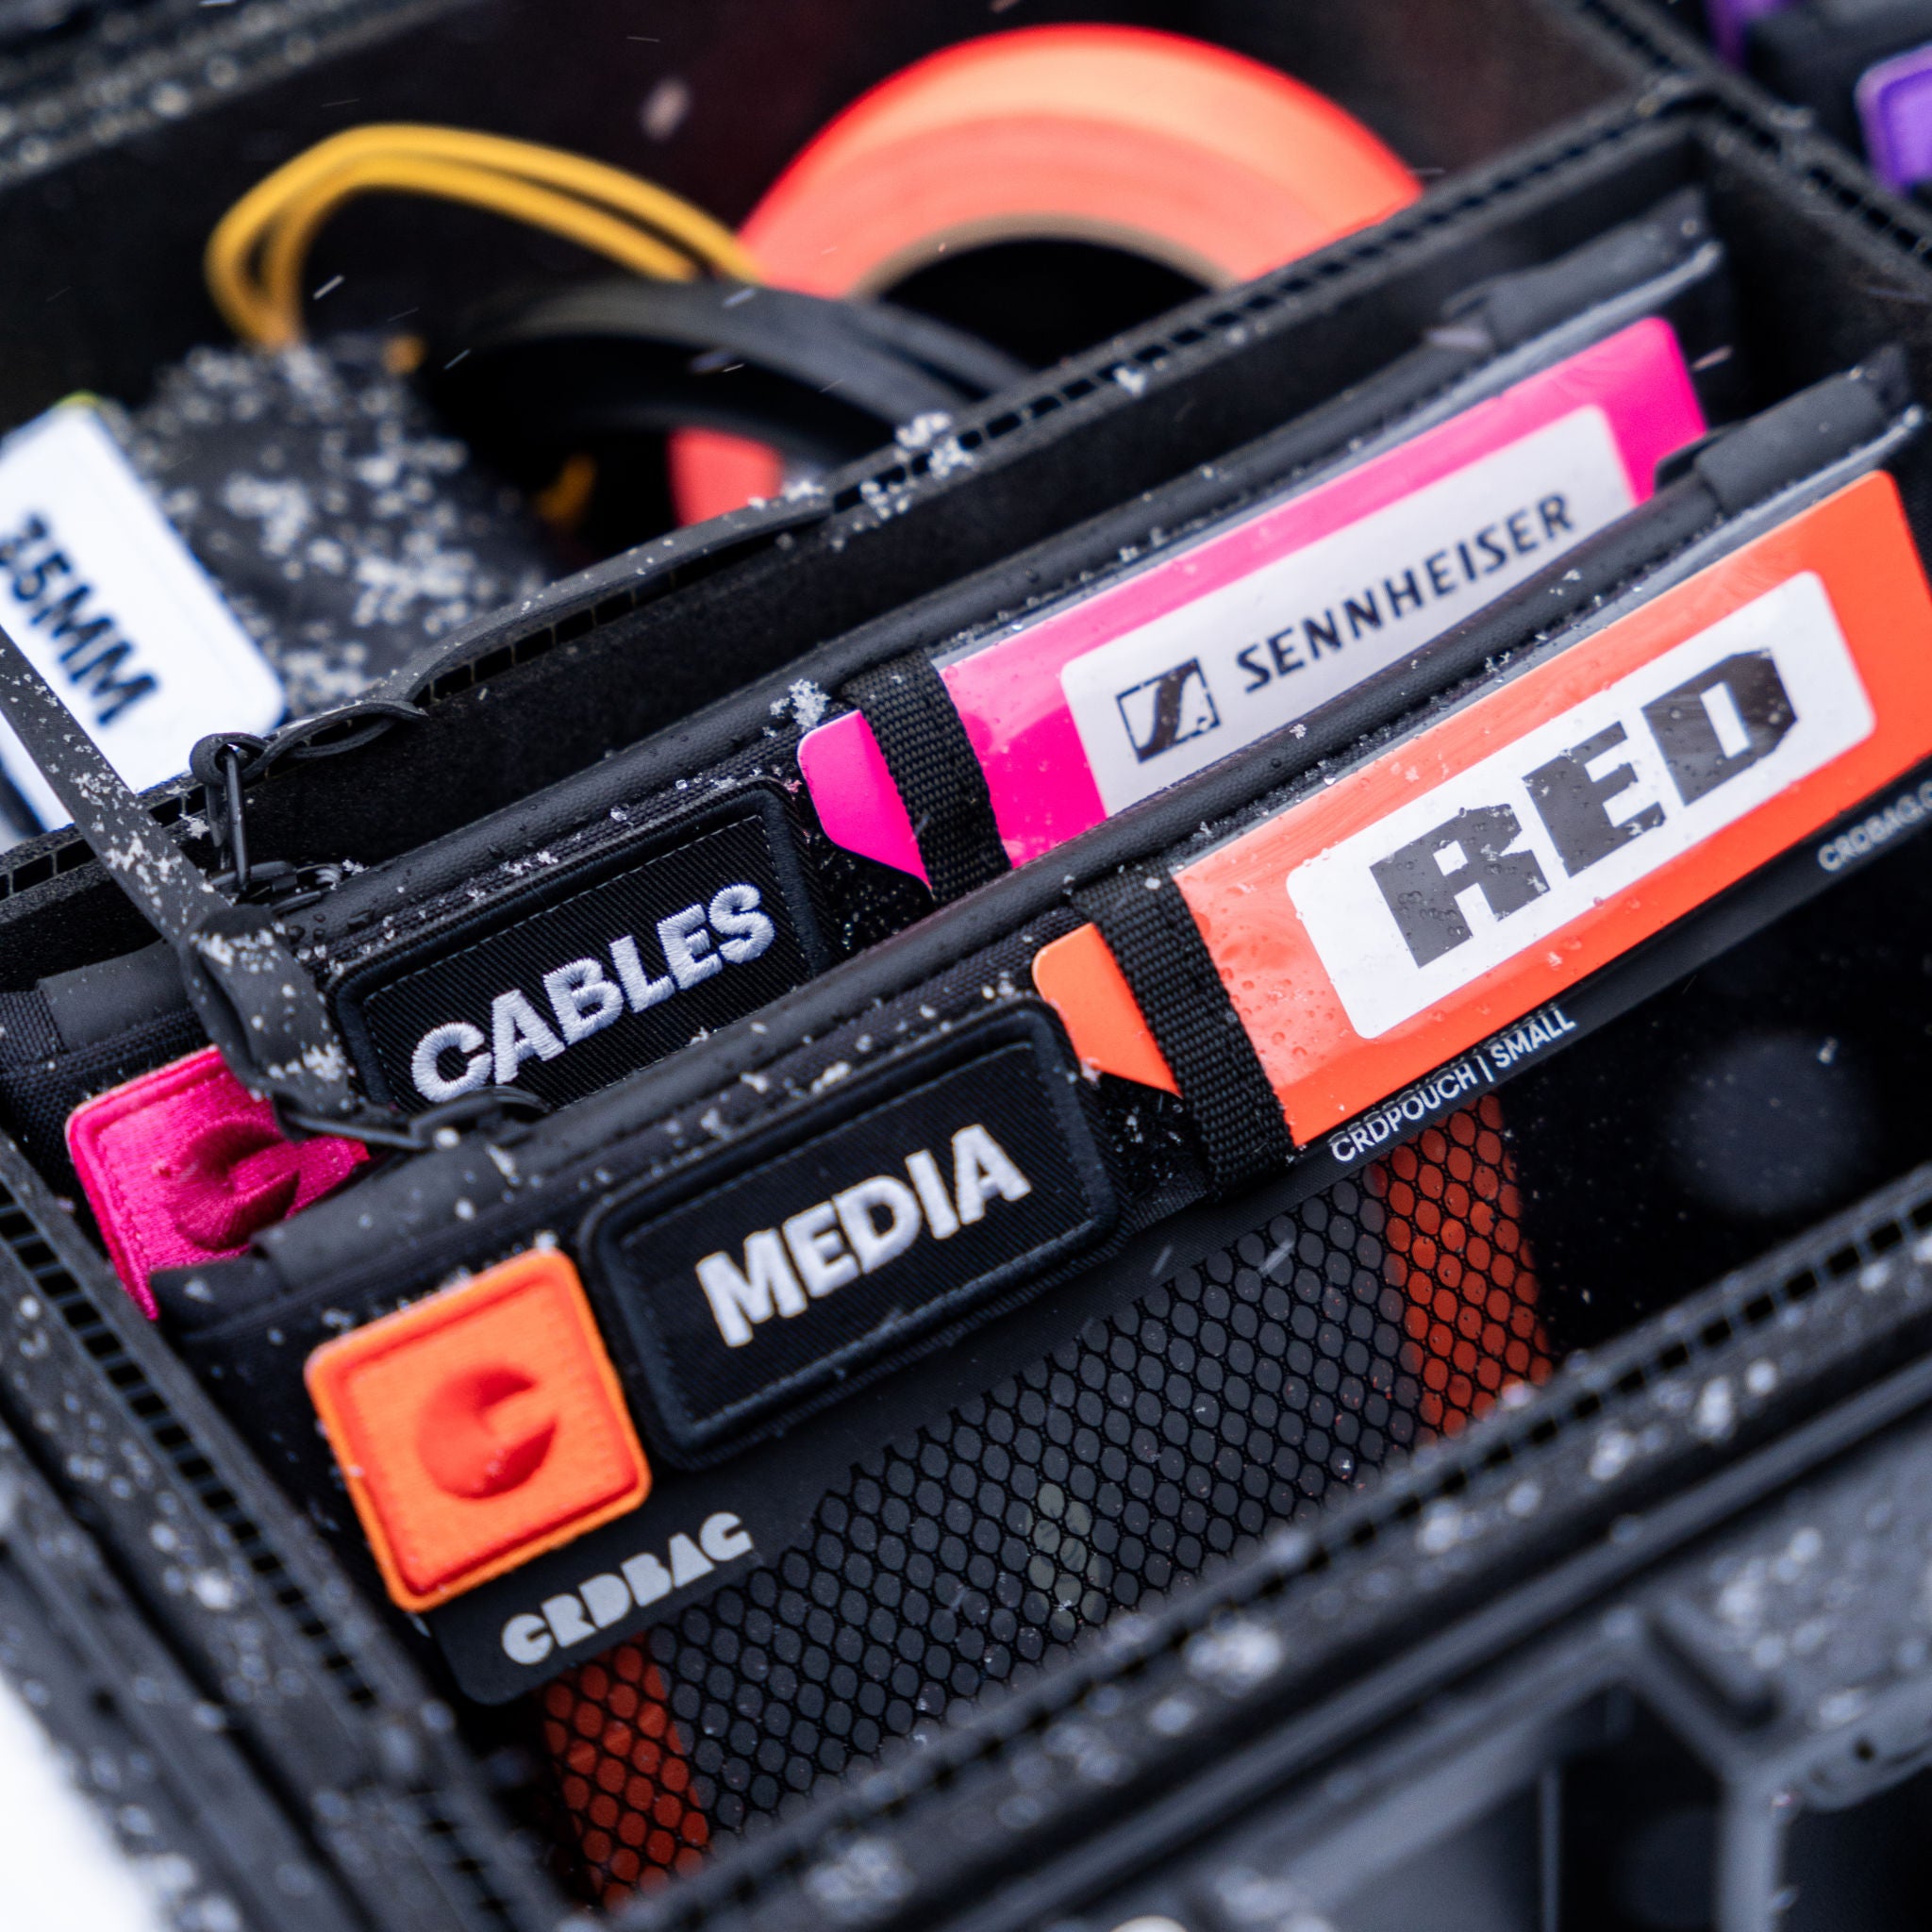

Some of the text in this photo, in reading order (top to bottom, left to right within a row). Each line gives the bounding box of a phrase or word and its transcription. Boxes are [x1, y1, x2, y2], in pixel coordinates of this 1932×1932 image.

[1236, 493, 1575, 694] SENNHEISER
[1370, 648, 1798, 969] RED
[411, 883, 775, 1104] CABLES
[1331, 1062, 1478, 1162] CRDPOUCH
[1491, 1009, 1577, 1068] SMALL
[695, 1124, 1032, 1347] MEDIA
